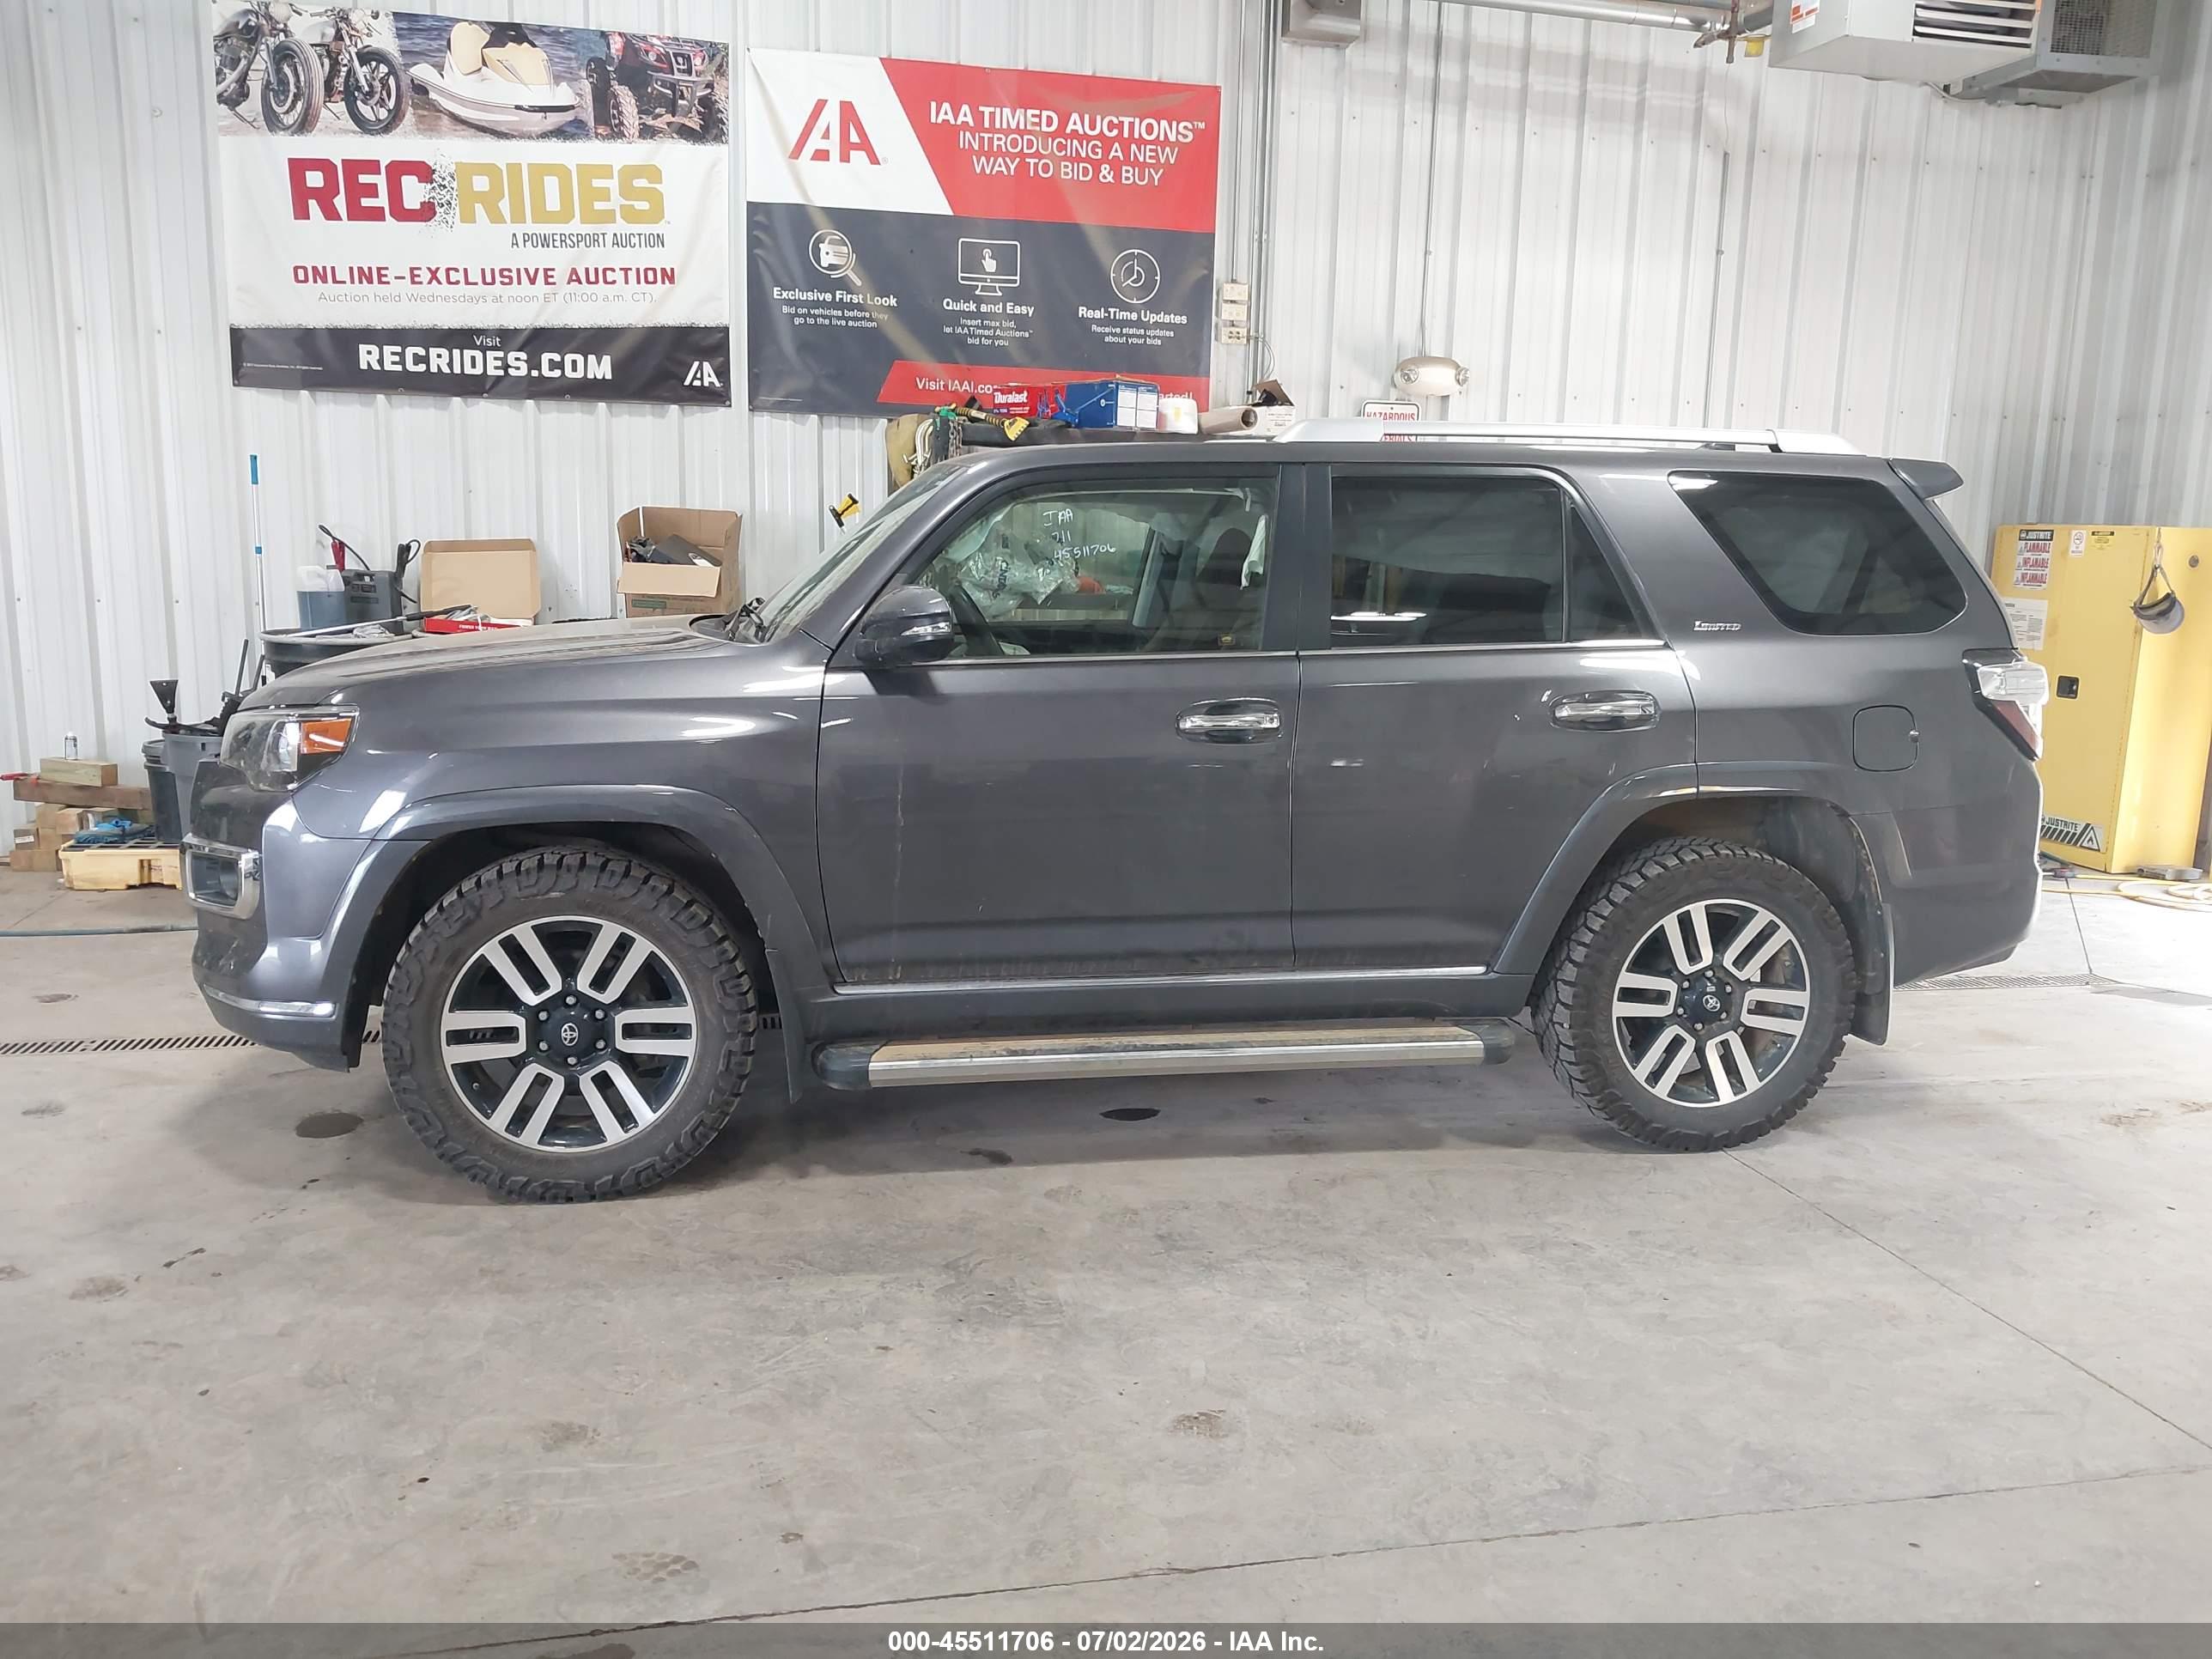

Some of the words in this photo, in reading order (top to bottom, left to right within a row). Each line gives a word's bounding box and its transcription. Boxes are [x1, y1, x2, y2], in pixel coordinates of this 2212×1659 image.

[929, 100, 975, 127] IAA
[978, 106, 1059, 133] TIMED
[958, 131, 1103, 160] INTRODUCING
[1108, 142, 1124, 160] A
[1130, 143, 1178, 164] NEW
[971, 155, 1020, 176] WAY
[1024, 158, 1054, 179] TO
[1060, 161, 1093, 180] BID
[1098, 164, 1115, 184] &
[1121, 166, 1164, 185] BUY
[288, 157, 437, 222] REC
[454, 161, 665, 224] RIDES
[511, 233, 520, 248] A
[523, 233, 607, 249] POWERSPORT
[611, 233, 665, 249] AUCTION
[293, 265, 557, 286] ONLINE-EXCLUSIVE
[566, 267, 676, 285] AUCTION
[318, 291, 372, 303] Auction
[374, 291, 401, 303] held
[405, 292, 488, 306] Wednesdays
[491, 293, 503, 304] at
[508, 295, 539, 304] noon
[544, 293, 559, 304] ET
[562, 292, 599, 304] (11:00
[603, 295, 627, 303] a.m.
[631, 292, 657, 304] CT).
[773, 287, 833, 301] Exclusive
[836, 290, 864, 304] First
[866, 294, 898, 307] Look
[782, 305, 796, 314] Bid
[810, 307, 842, 317] vehicles
[844, 308, 870, 319] before
[872, 311, 889, 321] they
[943, 298, 977, 313] Quick
[980, 302, 1003, 313] and
[1006, 302, 1035, 317] Easy
[1078, 306, 1138, 321] Real-Time
[1140, 309, 1188, 325] Updates
[793, 317, 805, 325] go
[817, 317, 830, 325] the
[831, 318, 846, 326] live
[848, 319, 878, 329] auction
[960, 317, 981, 326] Insert
[955, 325, 969, 335] IAA
[969, 327, 994, 337] Timed
[1091, 325, 1121, 334] Receive
[1122, 326, 1145, 335] status
[1146, 328, 1175, 337] updates
[473, 335, 501, 347] Visit
[981, 337, 993, 345] for
[1104, 335, 1127, 343] about
[1127, 337, 1145, 345] your
[1146, 337, 1162, 345] bids
[358, 343, 612, 380] RECRIDES.COM
[915, 377, 945, 391] Visit
[993, 390, 1028, 404] Duralast
[1042, 508, 1073, 526] IAA
[1054, 543, 1116, 560] 45511706
[2045, 817, 2079, 832] JUSTRITE
